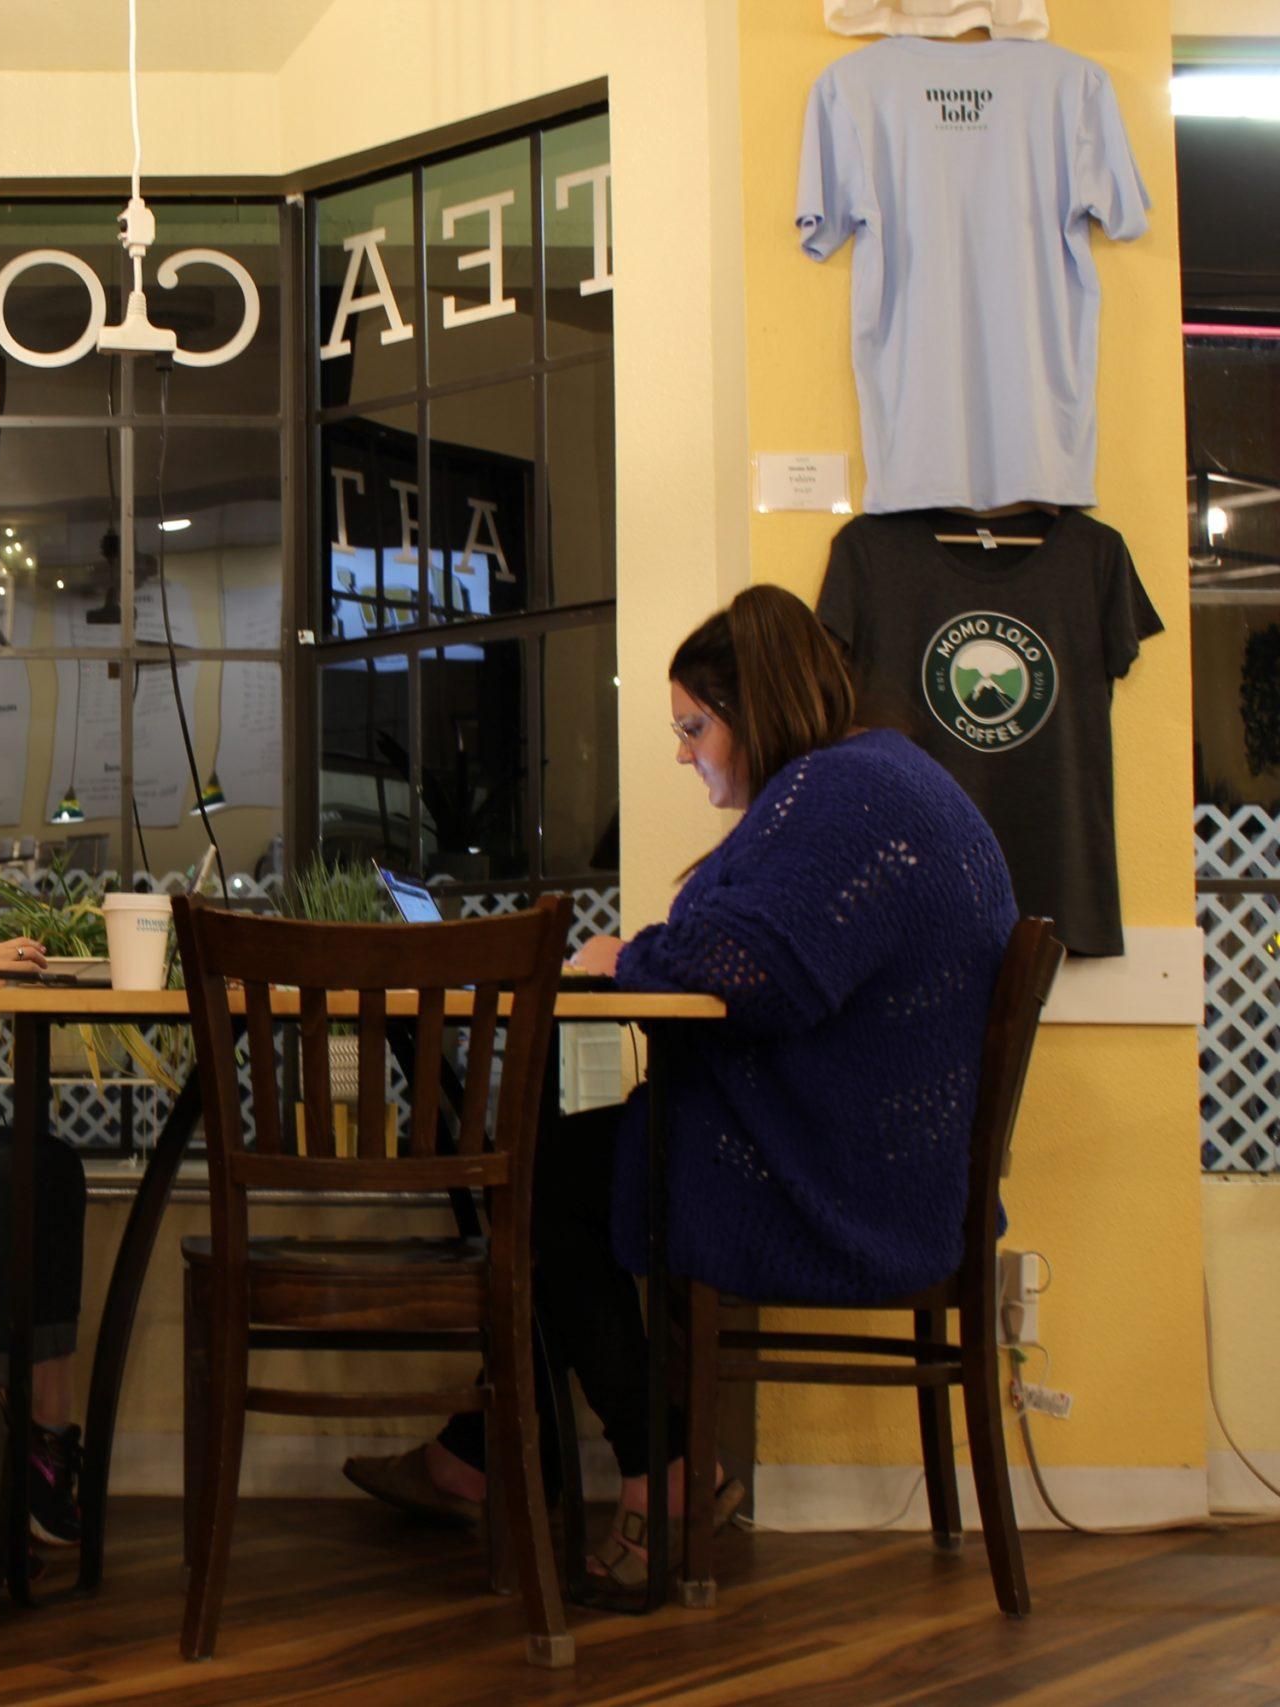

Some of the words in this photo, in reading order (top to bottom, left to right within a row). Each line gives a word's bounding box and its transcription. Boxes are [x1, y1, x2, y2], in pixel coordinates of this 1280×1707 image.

[925, 88, 993, 111] momo
[940, 104, 980, 123] lolo
[936, 619, 990, 659] MOMO
[995, 622, 1043, 662] LOLO
[955, 715, 1024, 744] COFFEE
